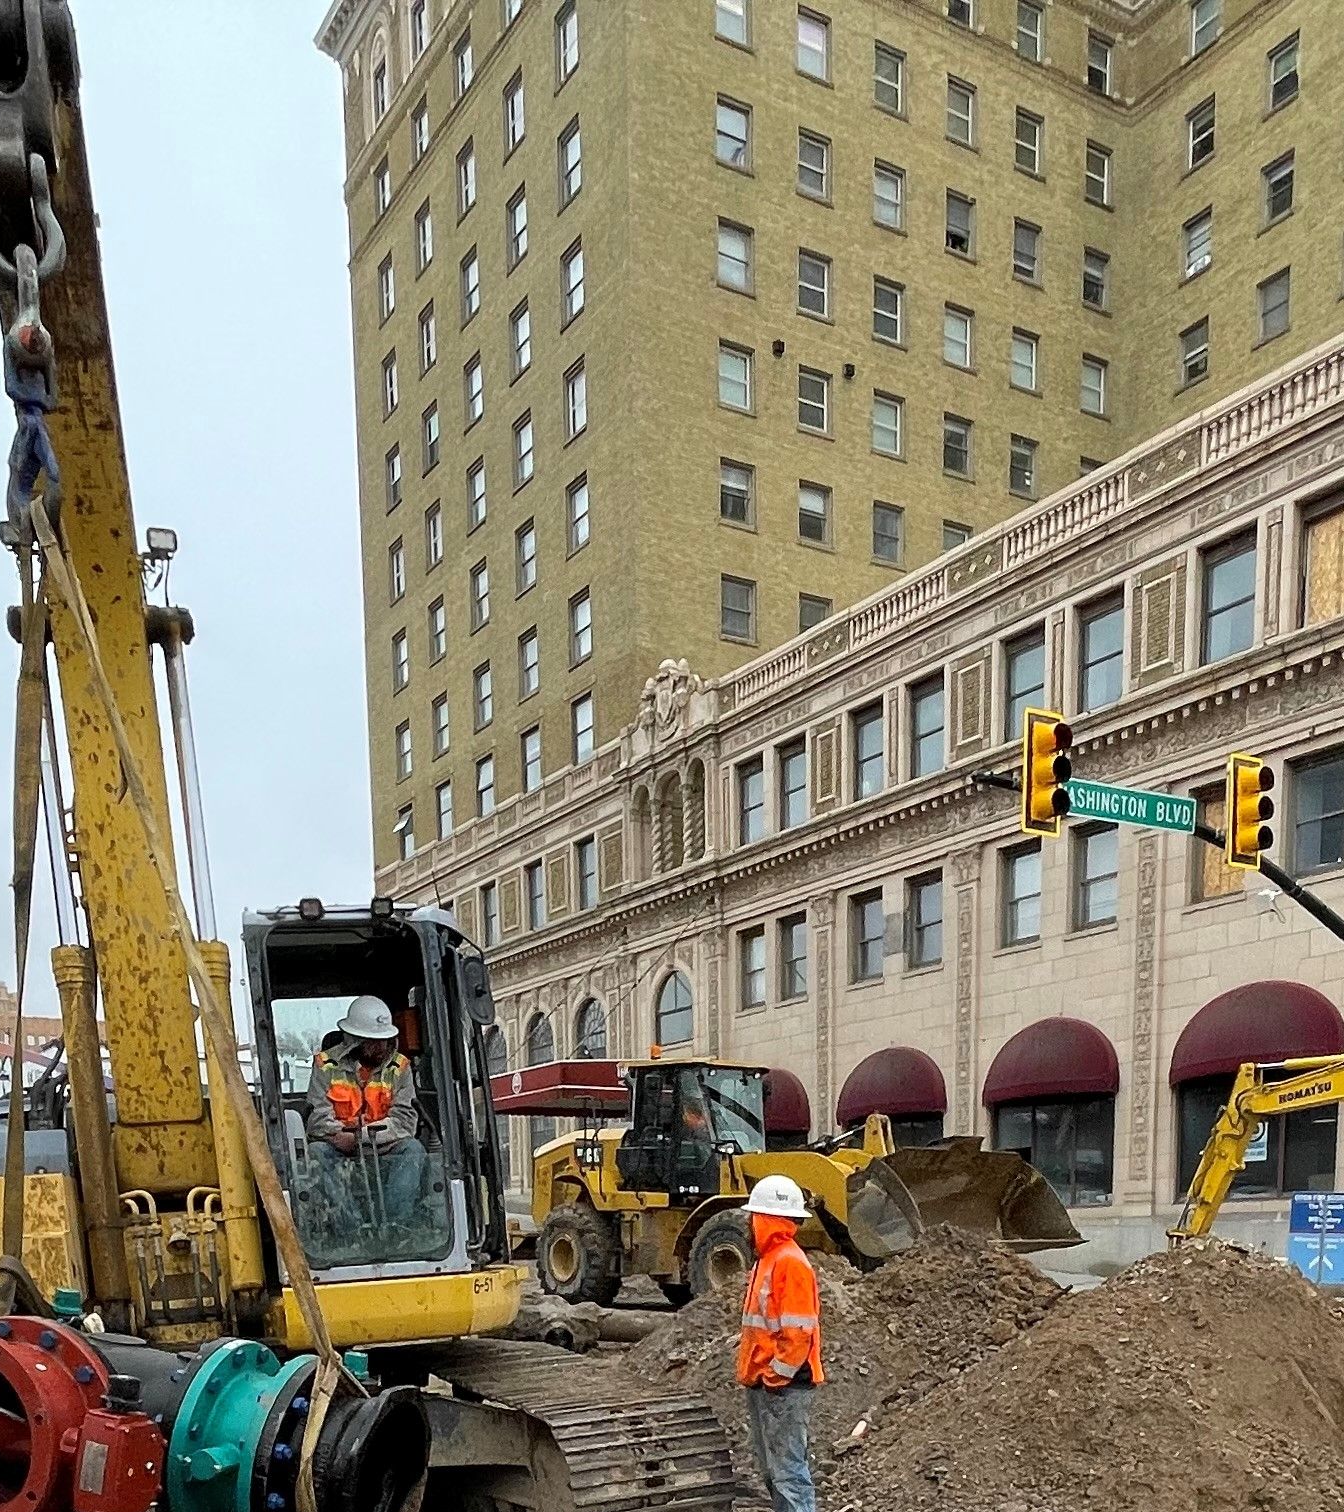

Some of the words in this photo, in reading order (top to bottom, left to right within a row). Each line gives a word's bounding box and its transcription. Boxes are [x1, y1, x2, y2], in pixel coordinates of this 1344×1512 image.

[1156, 801, 1193, 826] BLVD.
[1279, 1081, 1332, 1104] KOMATSU
[474, 1277, 493, 1294] 6-51
